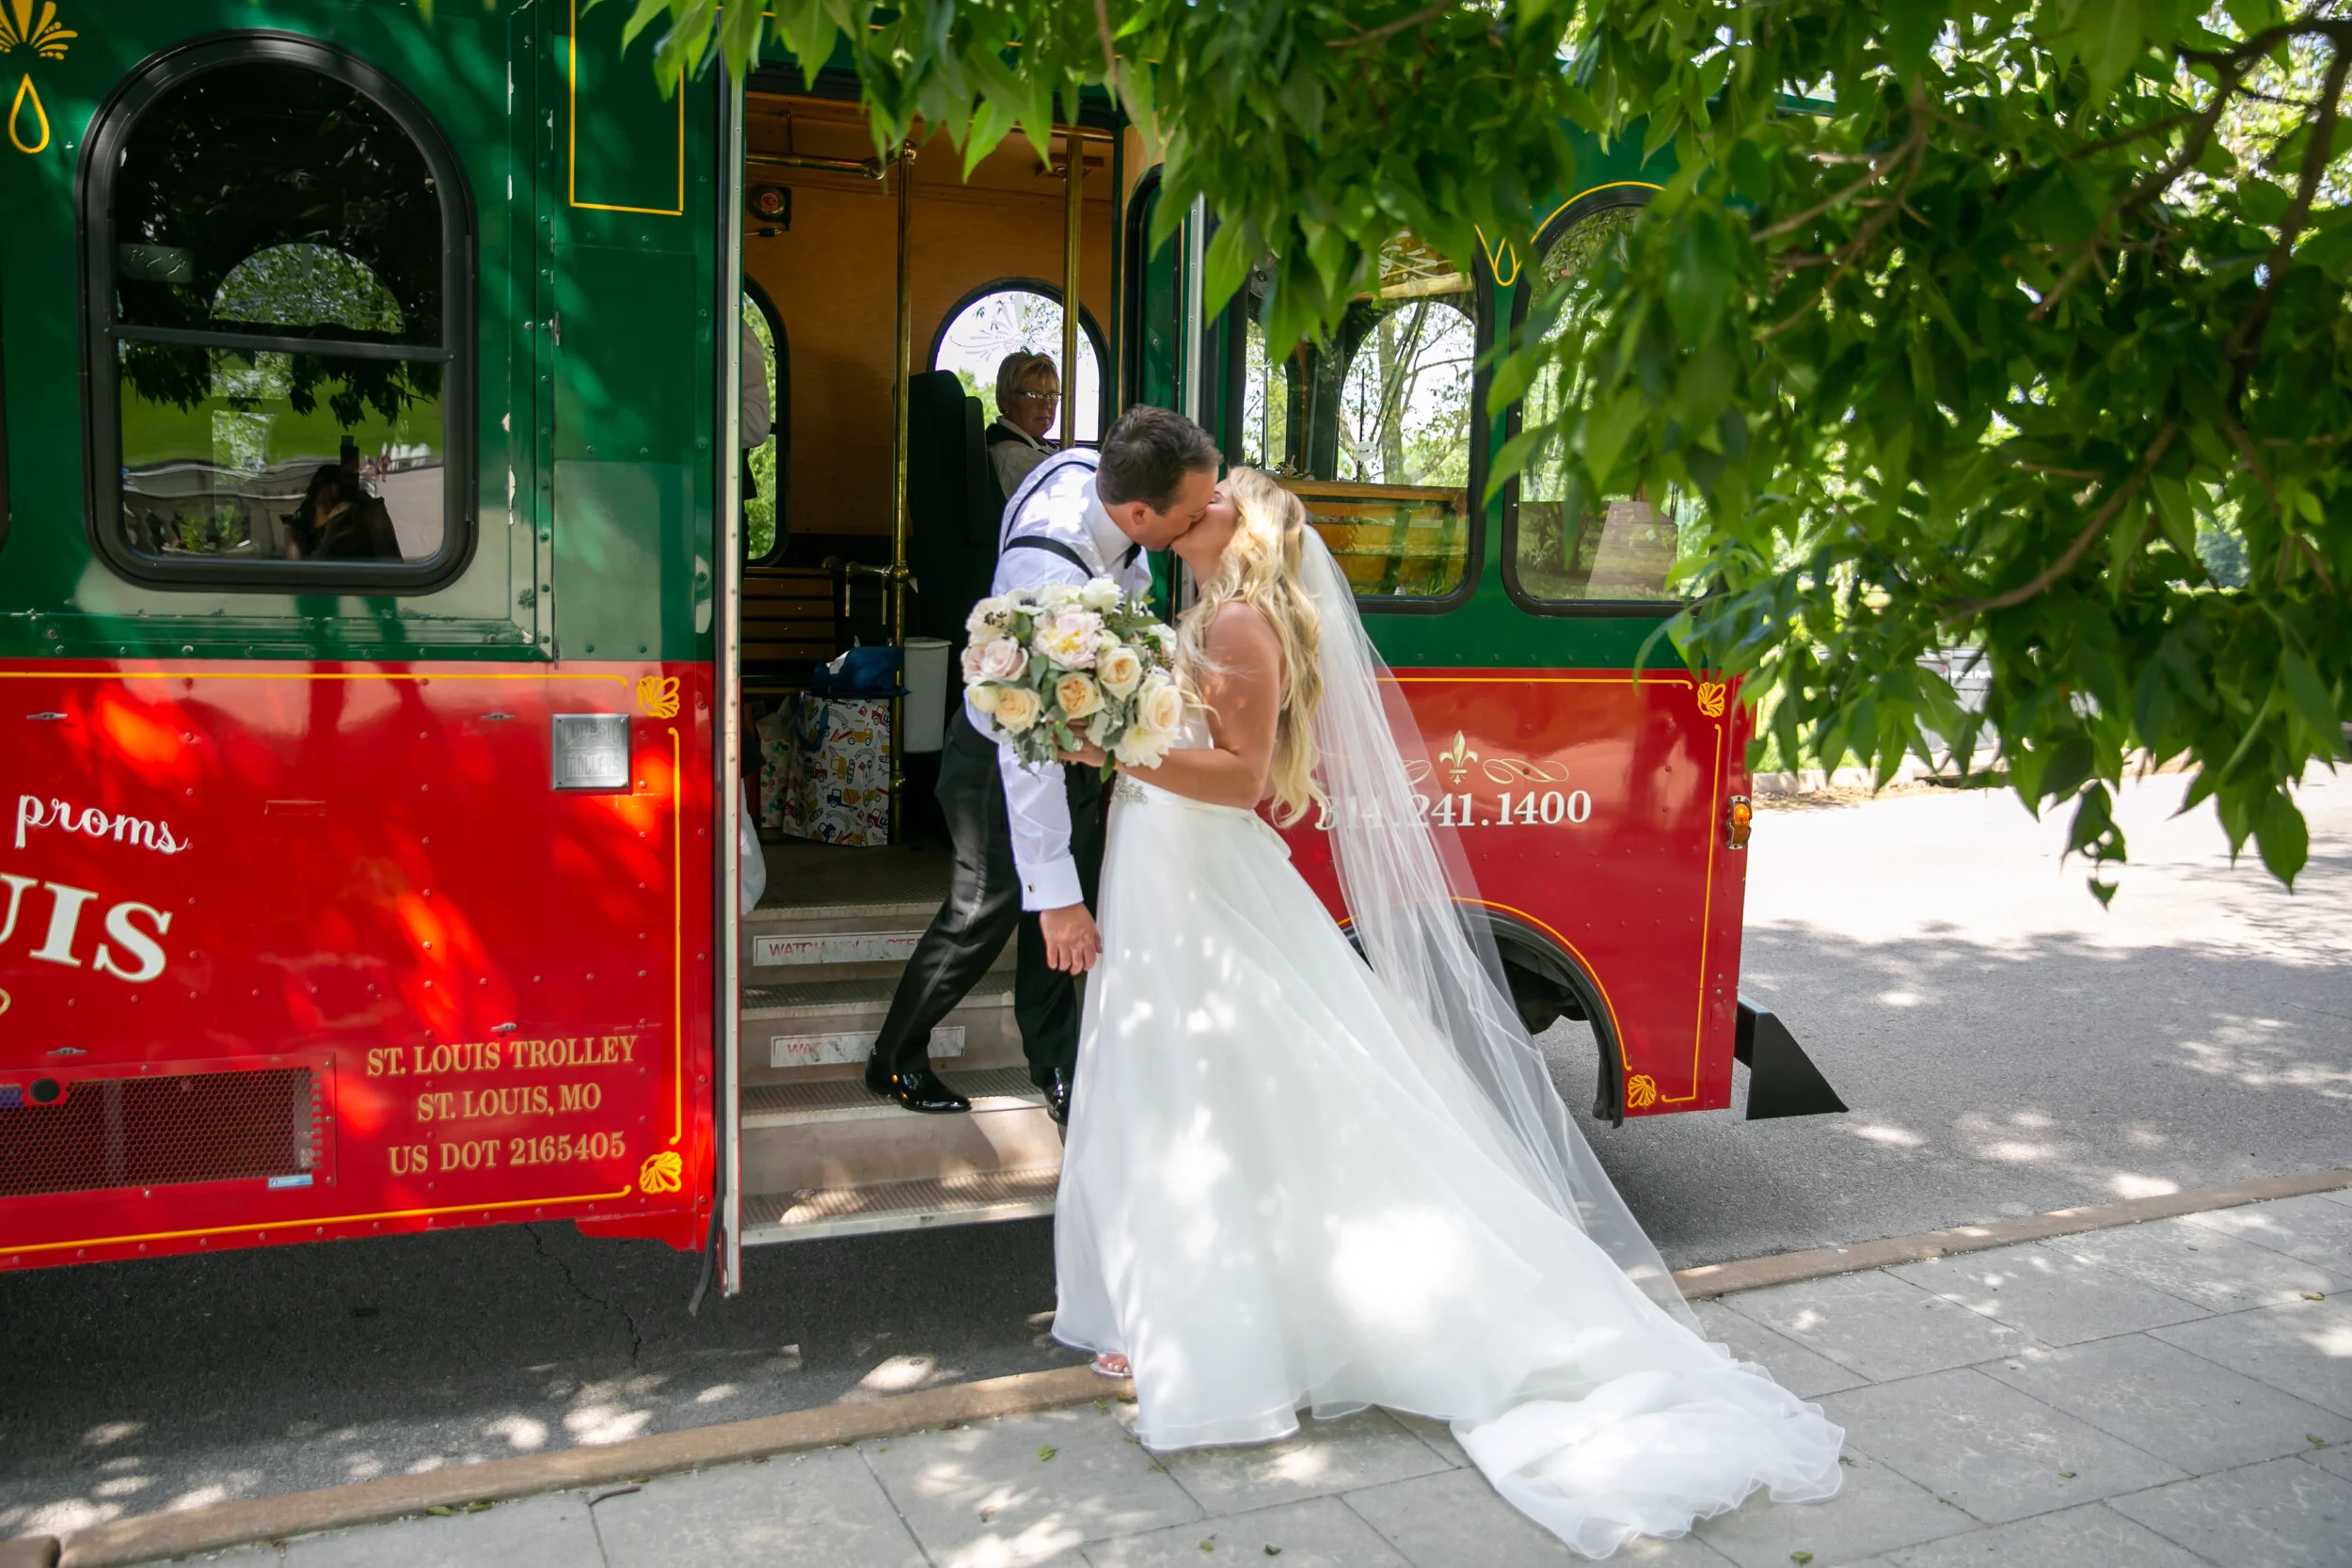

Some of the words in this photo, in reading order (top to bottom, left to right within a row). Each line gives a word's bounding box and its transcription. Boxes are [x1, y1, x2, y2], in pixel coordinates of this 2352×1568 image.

[1949, 670, 1973, 679] orest
[14, 795, 189, 855] proms
[366, 1047, 406, 1076] ST.
[414, 1041, 501, 1074] LOUIS
[509, 1034, 639, 1069] TROLLEY
[417, 1091, 456, 1122] ST.
[462, 1085, 554, 1117] LOUIS,
[558, 1082, 602, 1112] MO
[388, 1144, 429, 1175] US
[439, 1139, 501, 1171] DOT
[509, 1130, 626, 1166] 2165405
